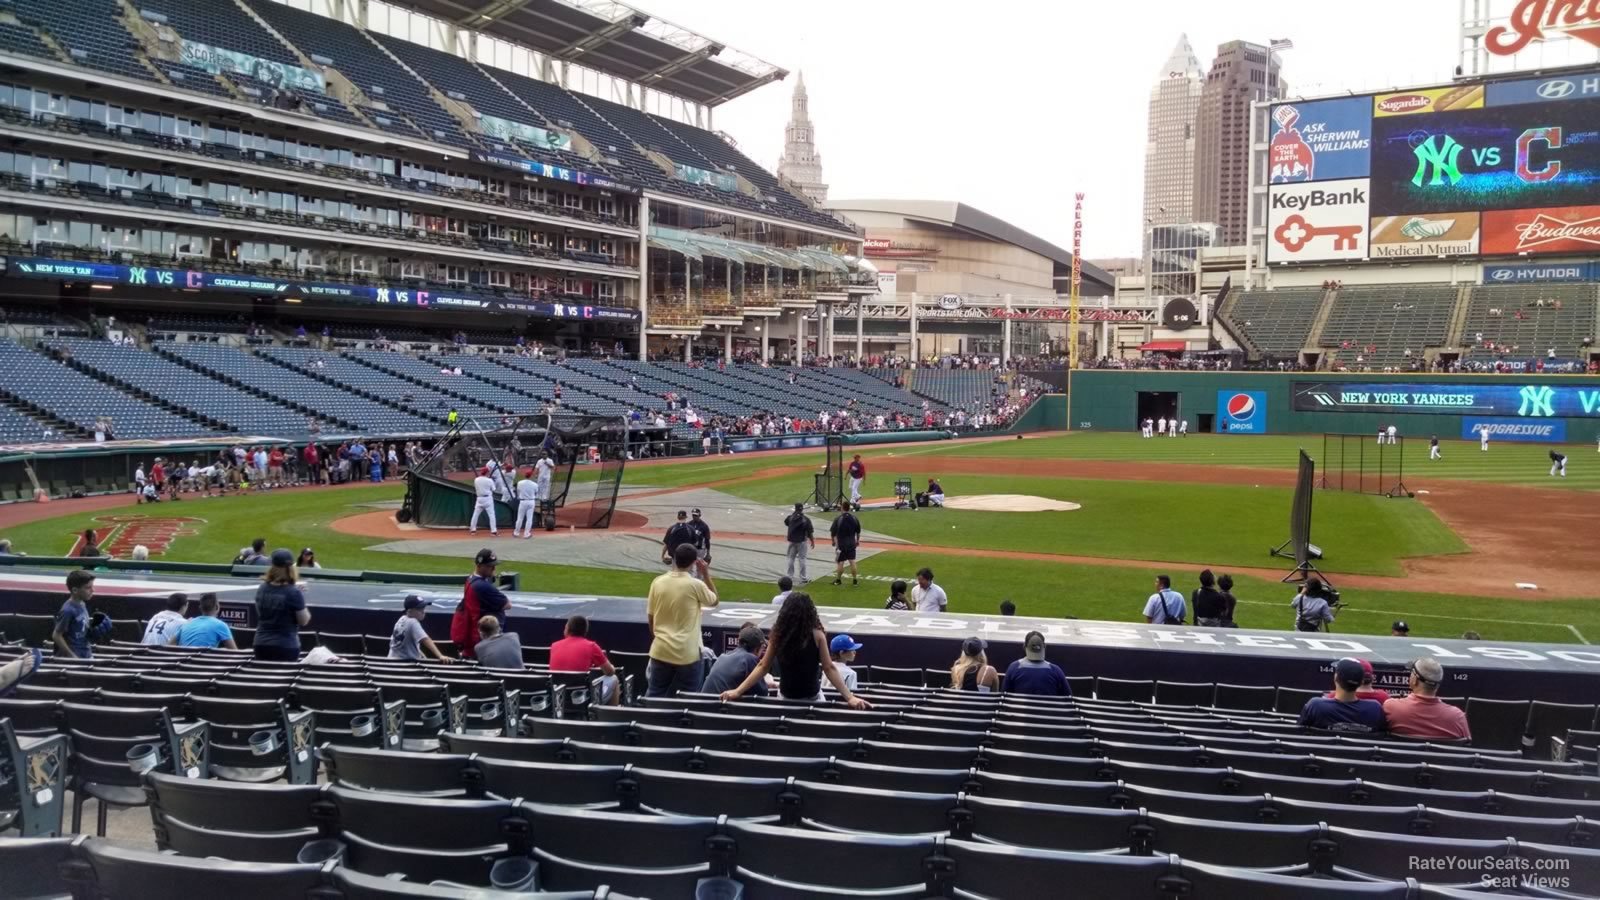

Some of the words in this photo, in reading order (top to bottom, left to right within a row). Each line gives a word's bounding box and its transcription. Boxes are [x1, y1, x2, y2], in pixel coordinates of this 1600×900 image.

[186, 45, 222, 65] SCORE
[1379, 97, 1431, 112] Sugardale
[1302, 123, 1326, 133] ASK
[1307, 130, 1360, 143] SHERWIN
[1313, 139, 1370, 152] WILLIAMS
[1472, 147, 1501, 166] VS
[1515, 127, 1562, 184] C
[559, 168, 570, 180] VS
[1272, 187, 1366, 211] KeyBank
[1073, 192, 1085, 274] WALGREENS
[863, 240, 889, 248] uicken
[1376, 245, 1424, 257] Medical
[1427, 242, 1471, 255] Mutual
[36, 264, 52, 272] NEW
[55, 265, 74, 274] YORK
[156, 271, 174, 284] VS
[187, 270, 202, 288] C
[214, 278, 249, 287] CLEVELAND
[1517, 268, 1580, 278] HYUNDAI
[395, 291, 409, 302] VS
[417, 291, 429, 306] C
[568, 306, 578, 316] VS
[1341, 392, 1369, 404] NEW
[1373, 393, 1408, 404] YORK
[1412, 394, 1474, 405] YANKEES
[1578, 391, 1600, 413] V
[220, 610, 246, 619] ALERT
[148, 621, 166, 634] 14
[701, 606, 1373, 653] SABLISHED
[1380, 675, 1409, 684] ALER
